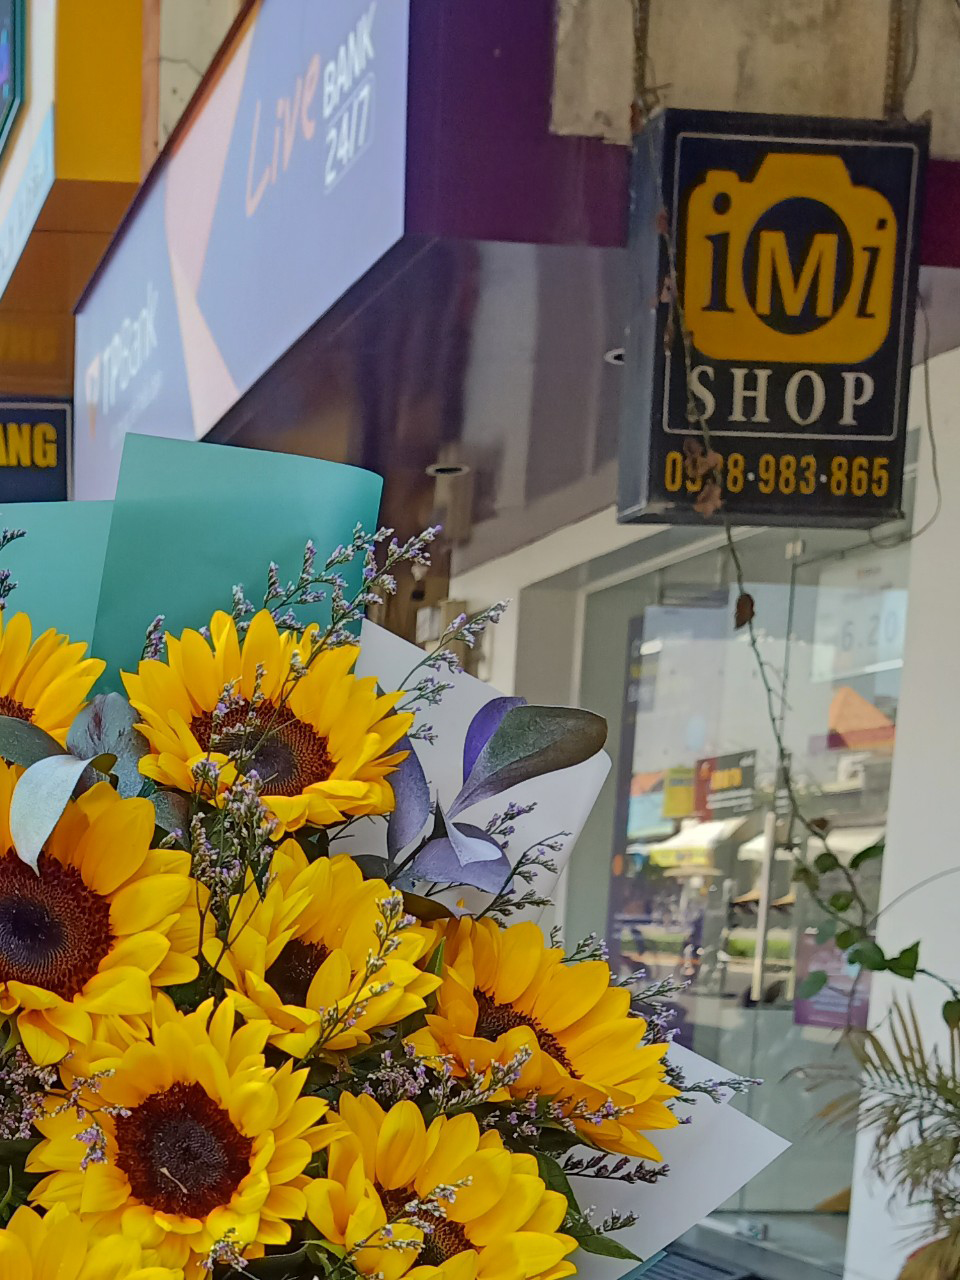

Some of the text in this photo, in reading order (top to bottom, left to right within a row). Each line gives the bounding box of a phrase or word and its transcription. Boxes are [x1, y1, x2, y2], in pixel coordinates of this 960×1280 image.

[323, 1, 376, 120] BANK
[246, 53, 320, 218] Live
[688, 364, 876, 427] SHOP
